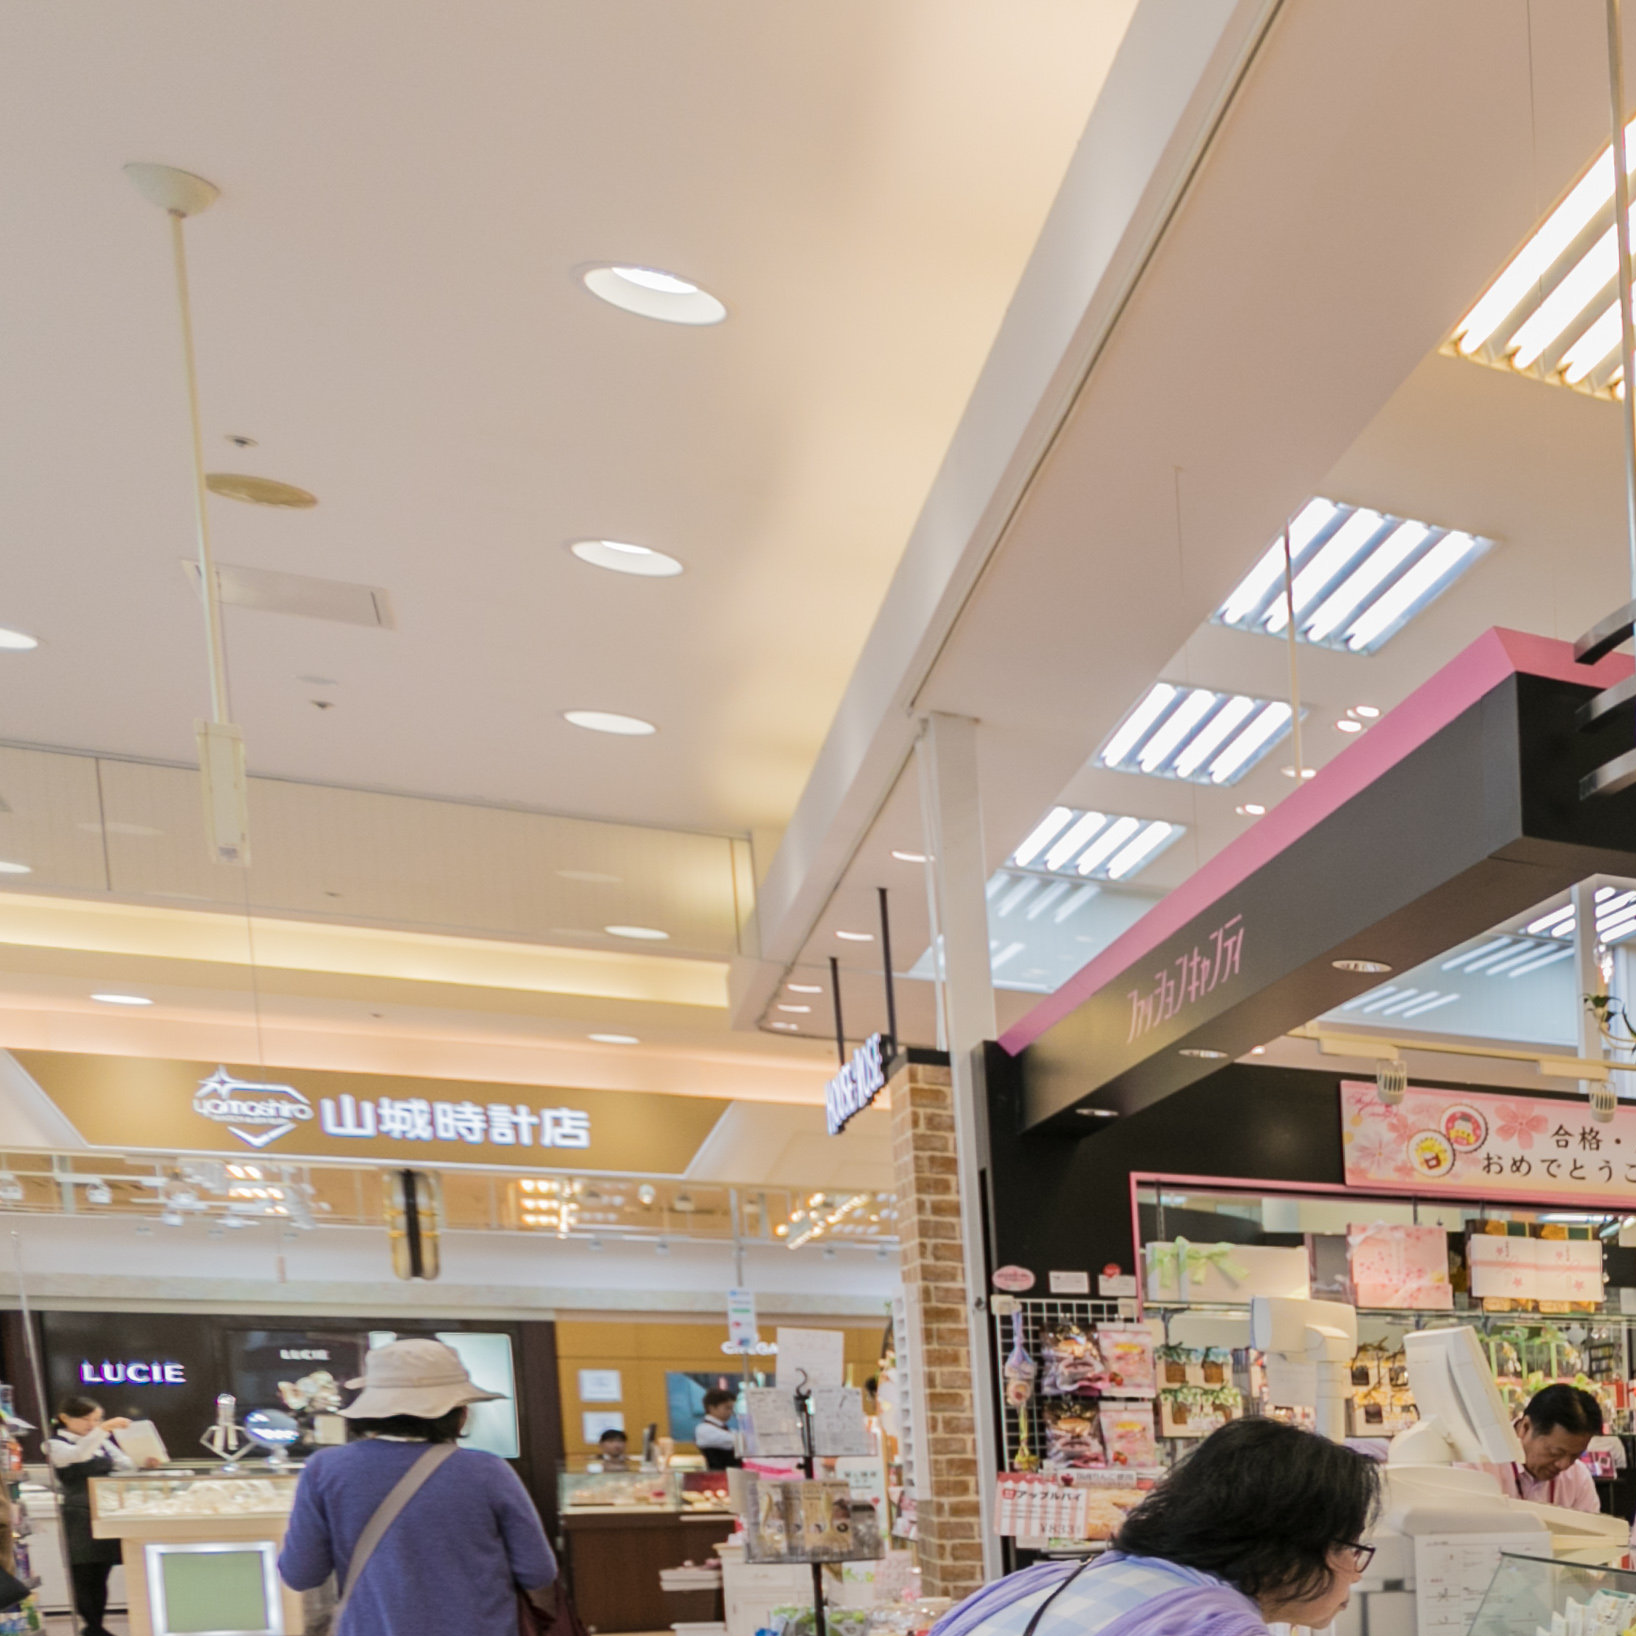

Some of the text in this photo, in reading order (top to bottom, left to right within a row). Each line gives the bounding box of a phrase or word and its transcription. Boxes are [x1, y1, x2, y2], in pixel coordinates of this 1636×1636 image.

[1126, 913, 1245, 1044] ファッションキャンディ
[320, 1093, 592, 1149] 山城時計店
[81, 1361, 187, 1385] LUCIE
[1016, 1489, 1083, 1501] アップルパイ
